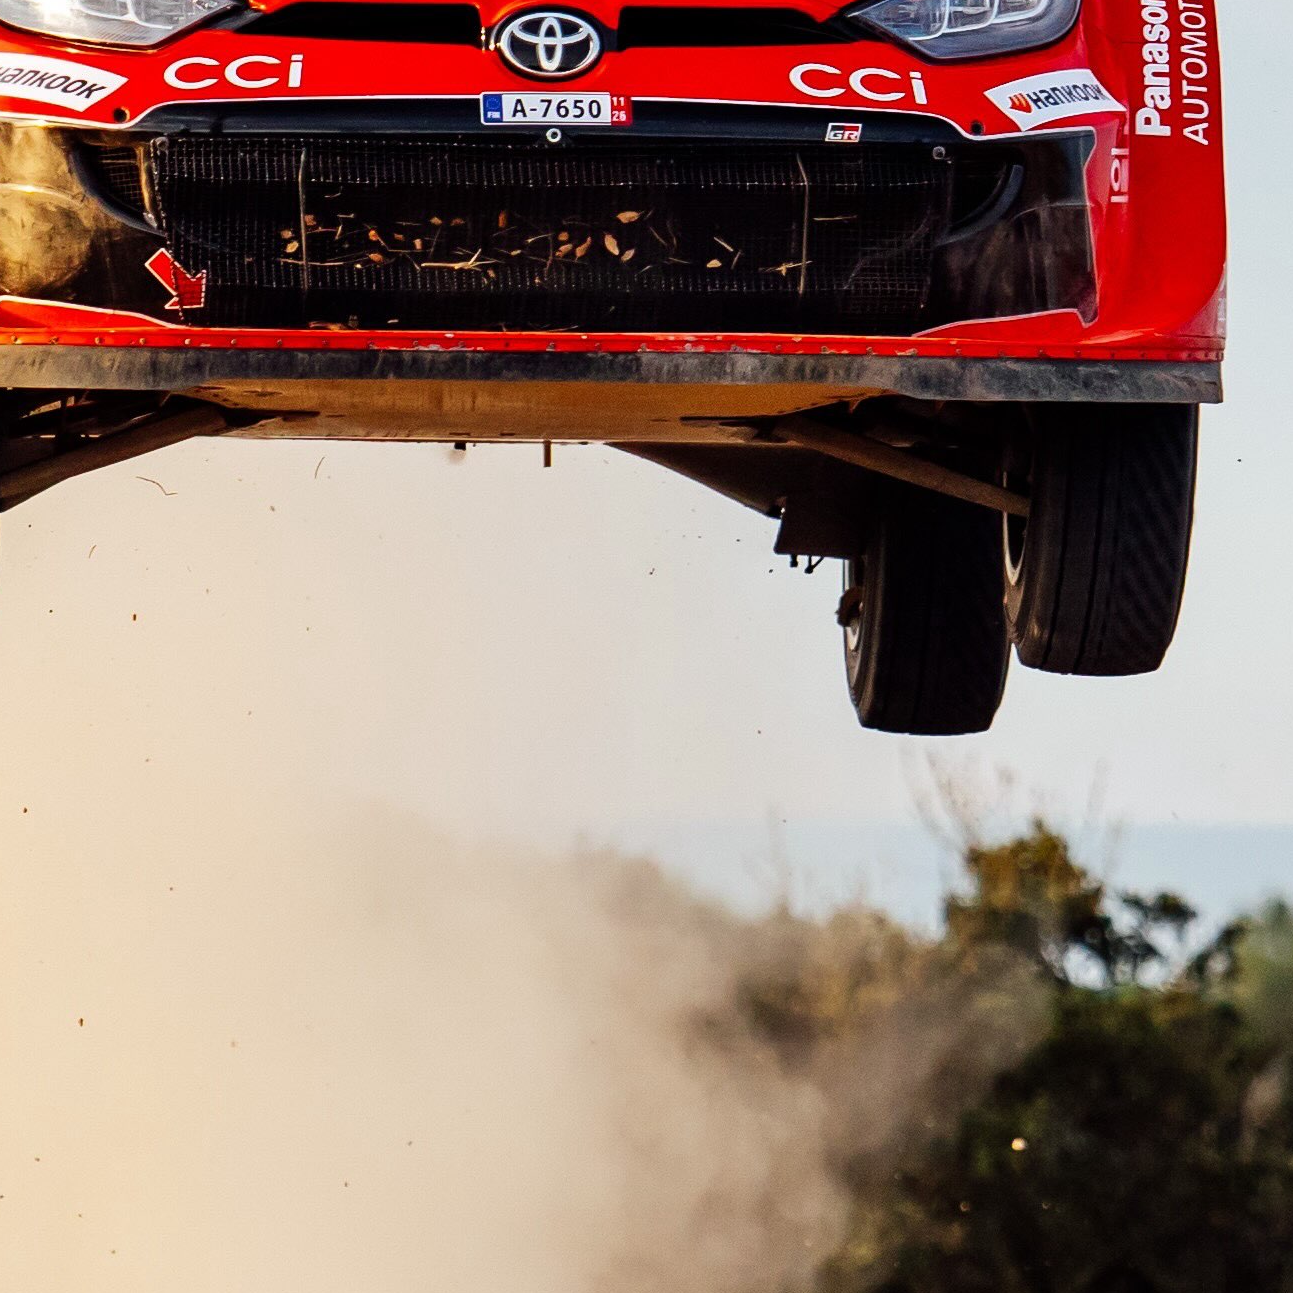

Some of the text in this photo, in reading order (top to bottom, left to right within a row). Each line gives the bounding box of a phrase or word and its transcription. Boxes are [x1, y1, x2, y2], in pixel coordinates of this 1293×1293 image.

[163, 53, 304, 90] CCi
[789, 62, 928, 105] CCi
[511, 98, 602, 119] A-7650
[611, 96, 625, 107] 11
[611, 110, 627, 122] 26
